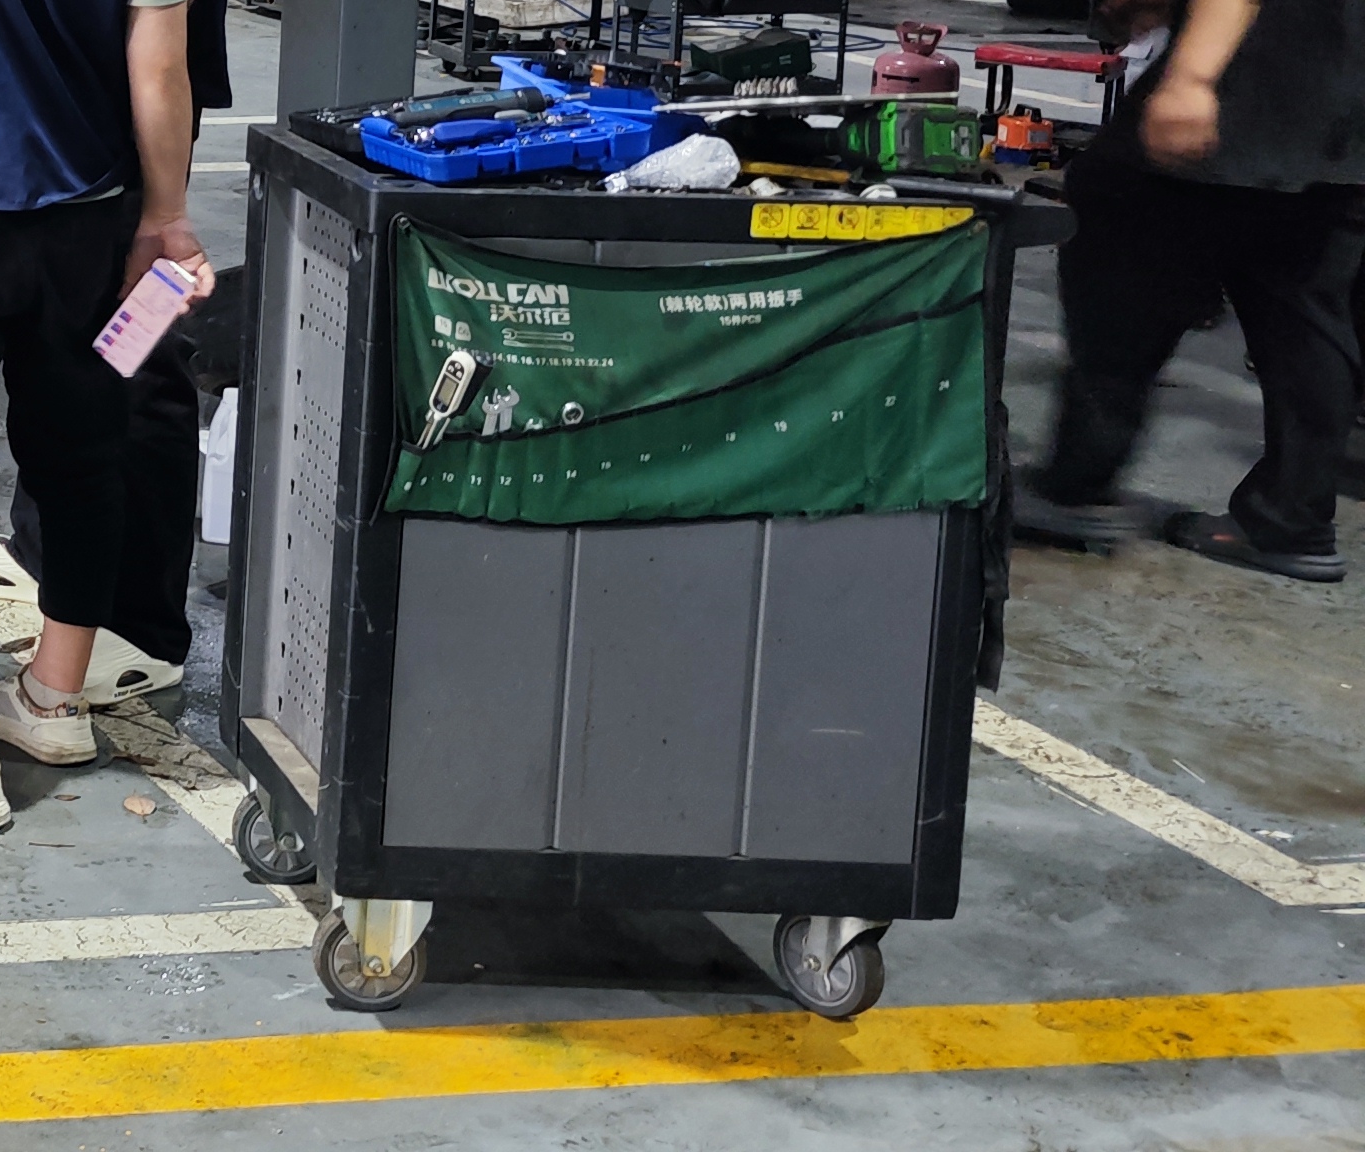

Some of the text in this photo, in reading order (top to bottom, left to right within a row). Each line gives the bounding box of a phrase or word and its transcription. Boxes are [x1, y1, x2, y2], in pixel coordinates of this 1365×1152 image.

[490, 304, 571, 325] 沃尔范
[442, 472, 454, 483] 10
[470, 474, 482, 486] 11
[500, 475, 512, 486] 12
[532, 473, 544, 484] 13
[566, 469, 577, 480] 14
[774, 420, 787, 432] 19
[831, 410, 844, 422] 21
